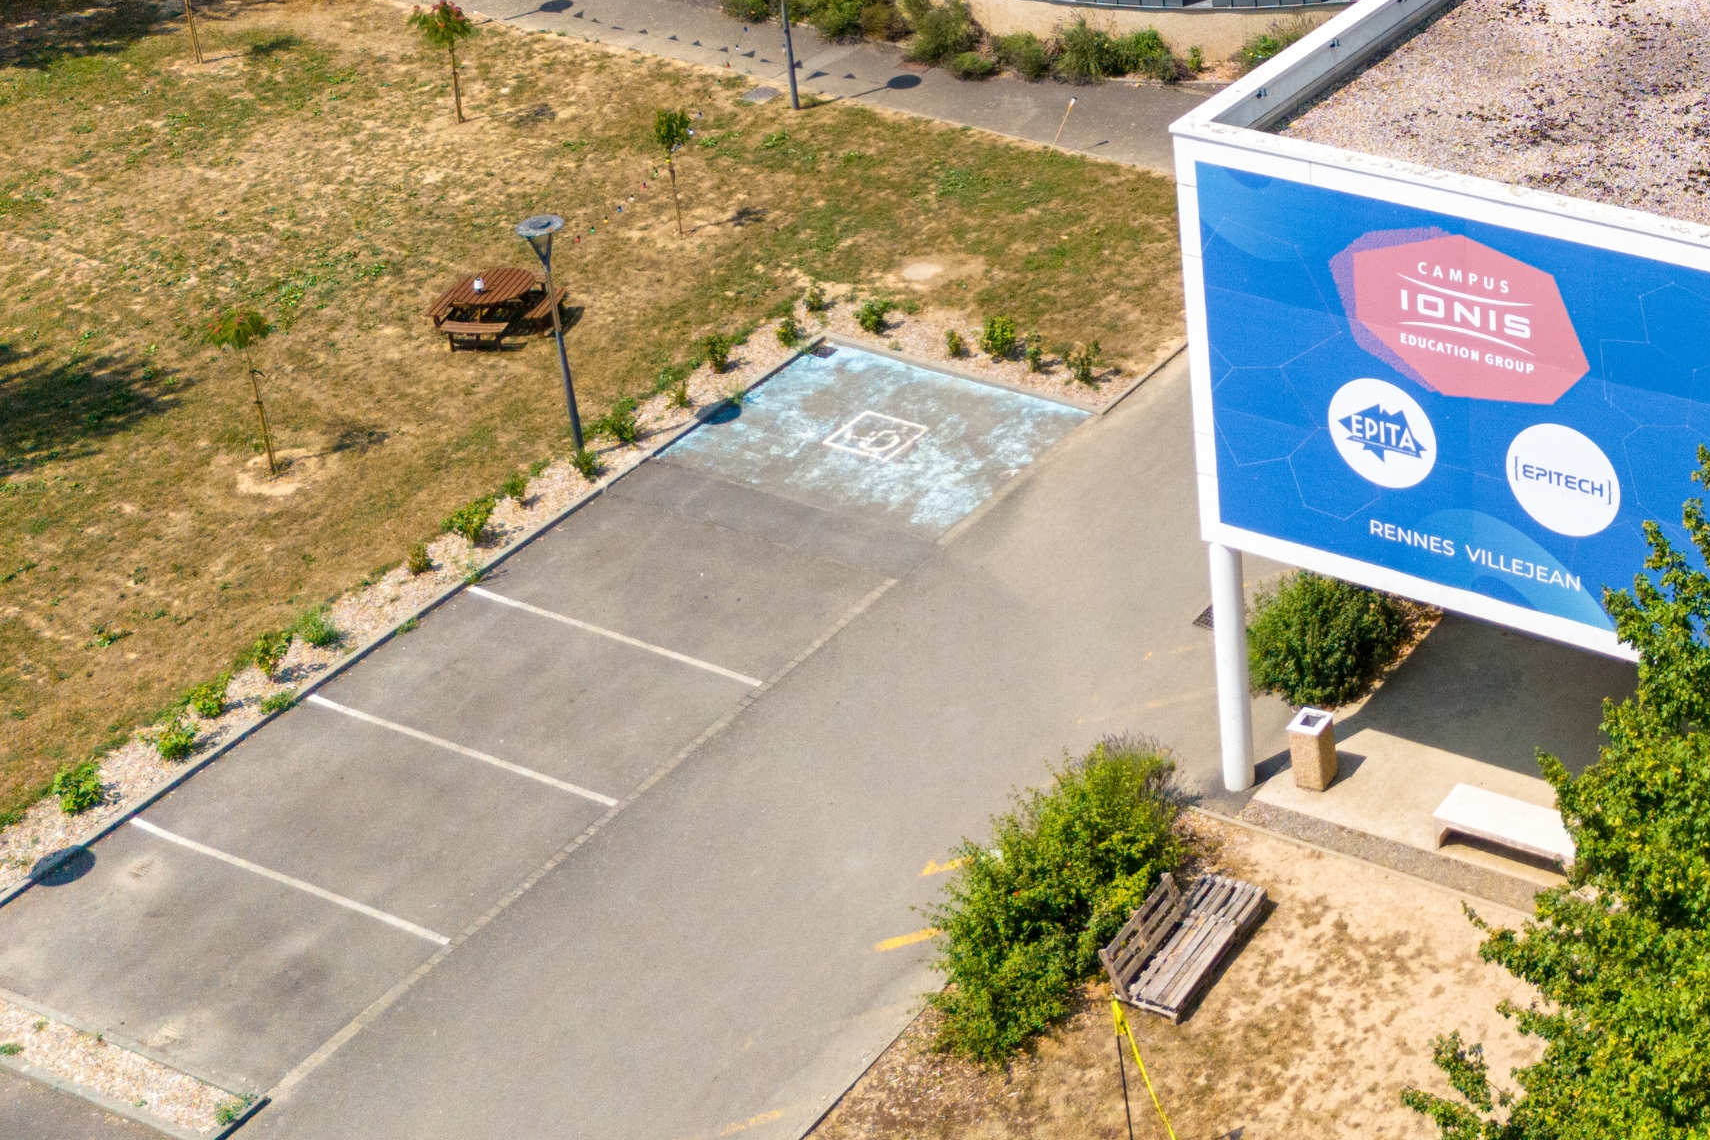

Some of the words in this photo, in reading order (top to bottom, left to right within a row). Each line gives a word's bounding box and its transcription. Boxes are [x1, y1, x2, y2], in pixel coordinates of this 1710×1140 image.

[1417, 261, 1509, 294] CAMPUS
[1401, 289, 1531, 339] IONIS
[1400, 332, 1480, 362] EDUCATION
[1484, 353, 1535, 374] GROUP
[1351, 414, 1417, 452] EPITA
[1369, 519, 1456, 557] RENNES
[1465, 544, 1581, 592] VILLEJEAN
